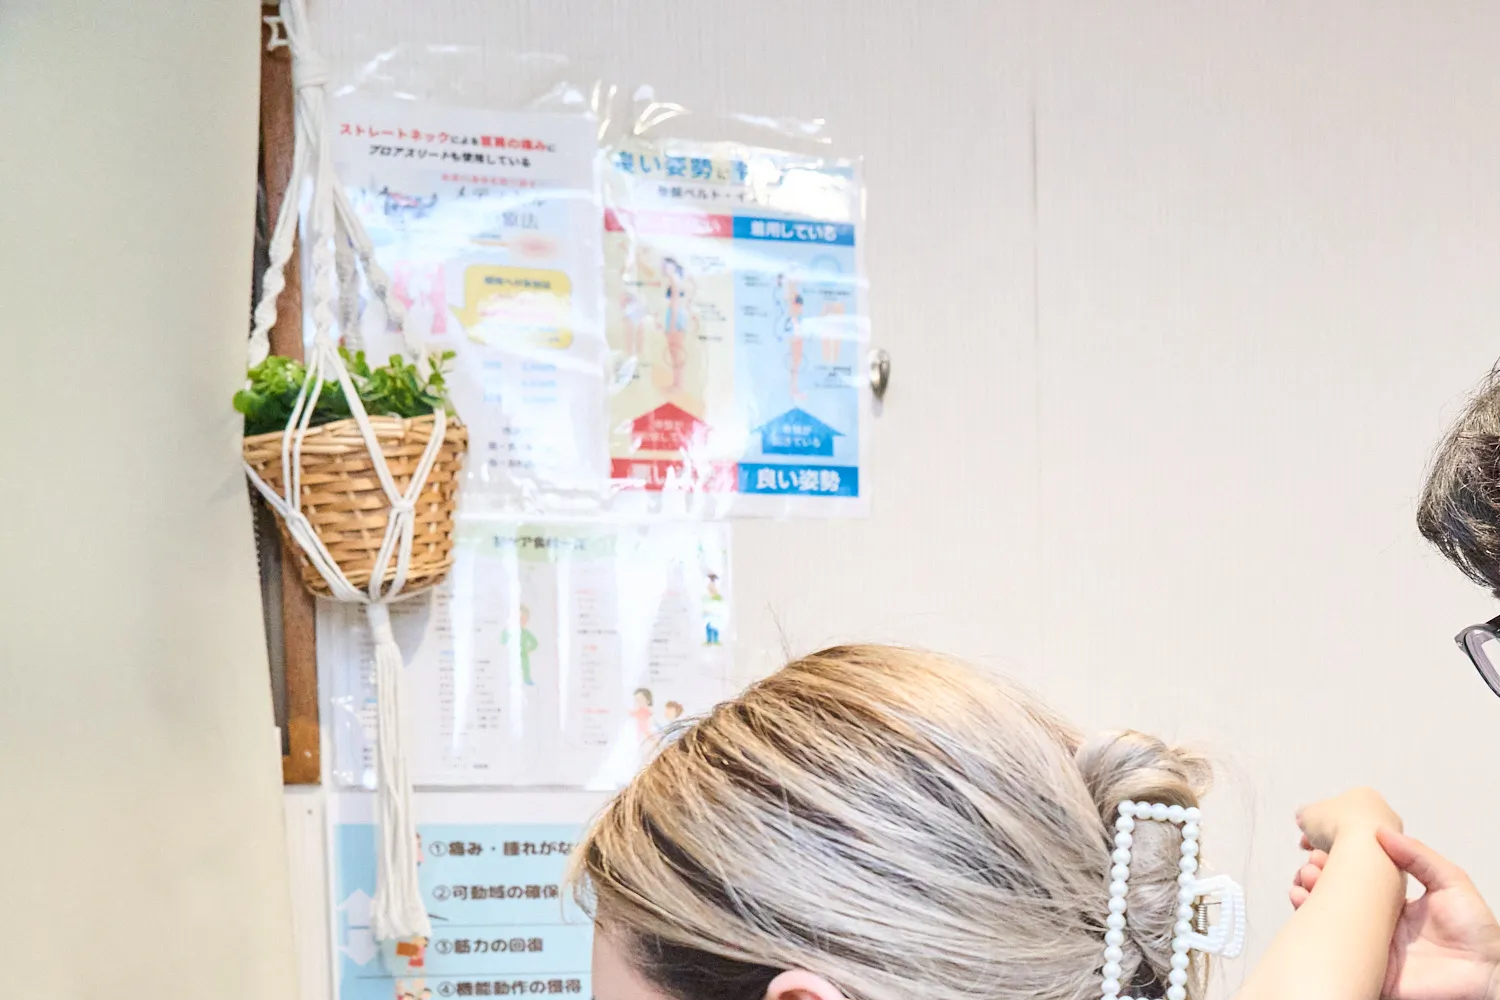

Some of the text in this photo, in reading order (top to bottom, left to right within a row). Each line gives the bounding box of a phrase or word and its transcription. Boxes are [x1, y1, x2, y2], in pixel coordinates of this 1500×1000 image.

[756, 467, 841, 492] 良い姿勢
[432, 884, 560, 900] ②可動域の確保
[434, 937, 543, 955] ③筋力の回復
[437, 979, 581, 997] ④機能動作の獲得
